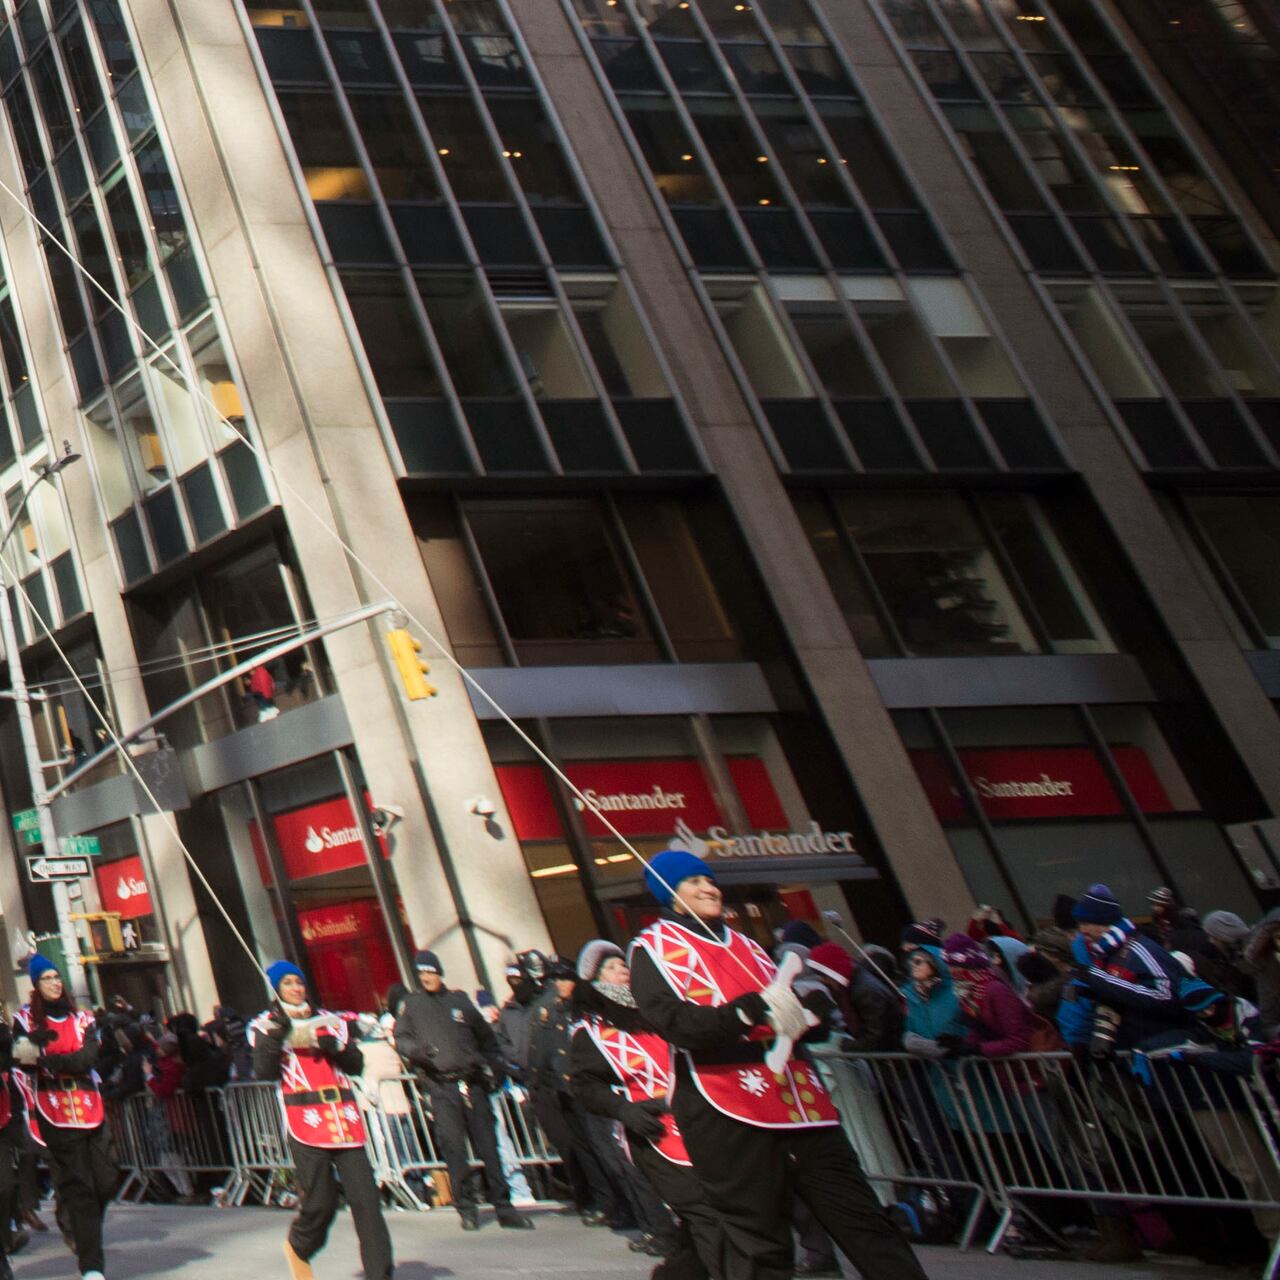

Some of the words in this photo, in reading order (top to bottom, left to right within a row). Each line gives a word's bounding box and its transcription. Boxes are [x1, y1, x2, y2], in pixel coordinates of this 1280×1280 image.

[583, 785, 686, 812] Santander
[974, 772, 1075, 799] Santander
[708, 821, 857, 858] Santander
[40, 862, 55, 873] ONE
[64, 862, 82, 872] WAY
